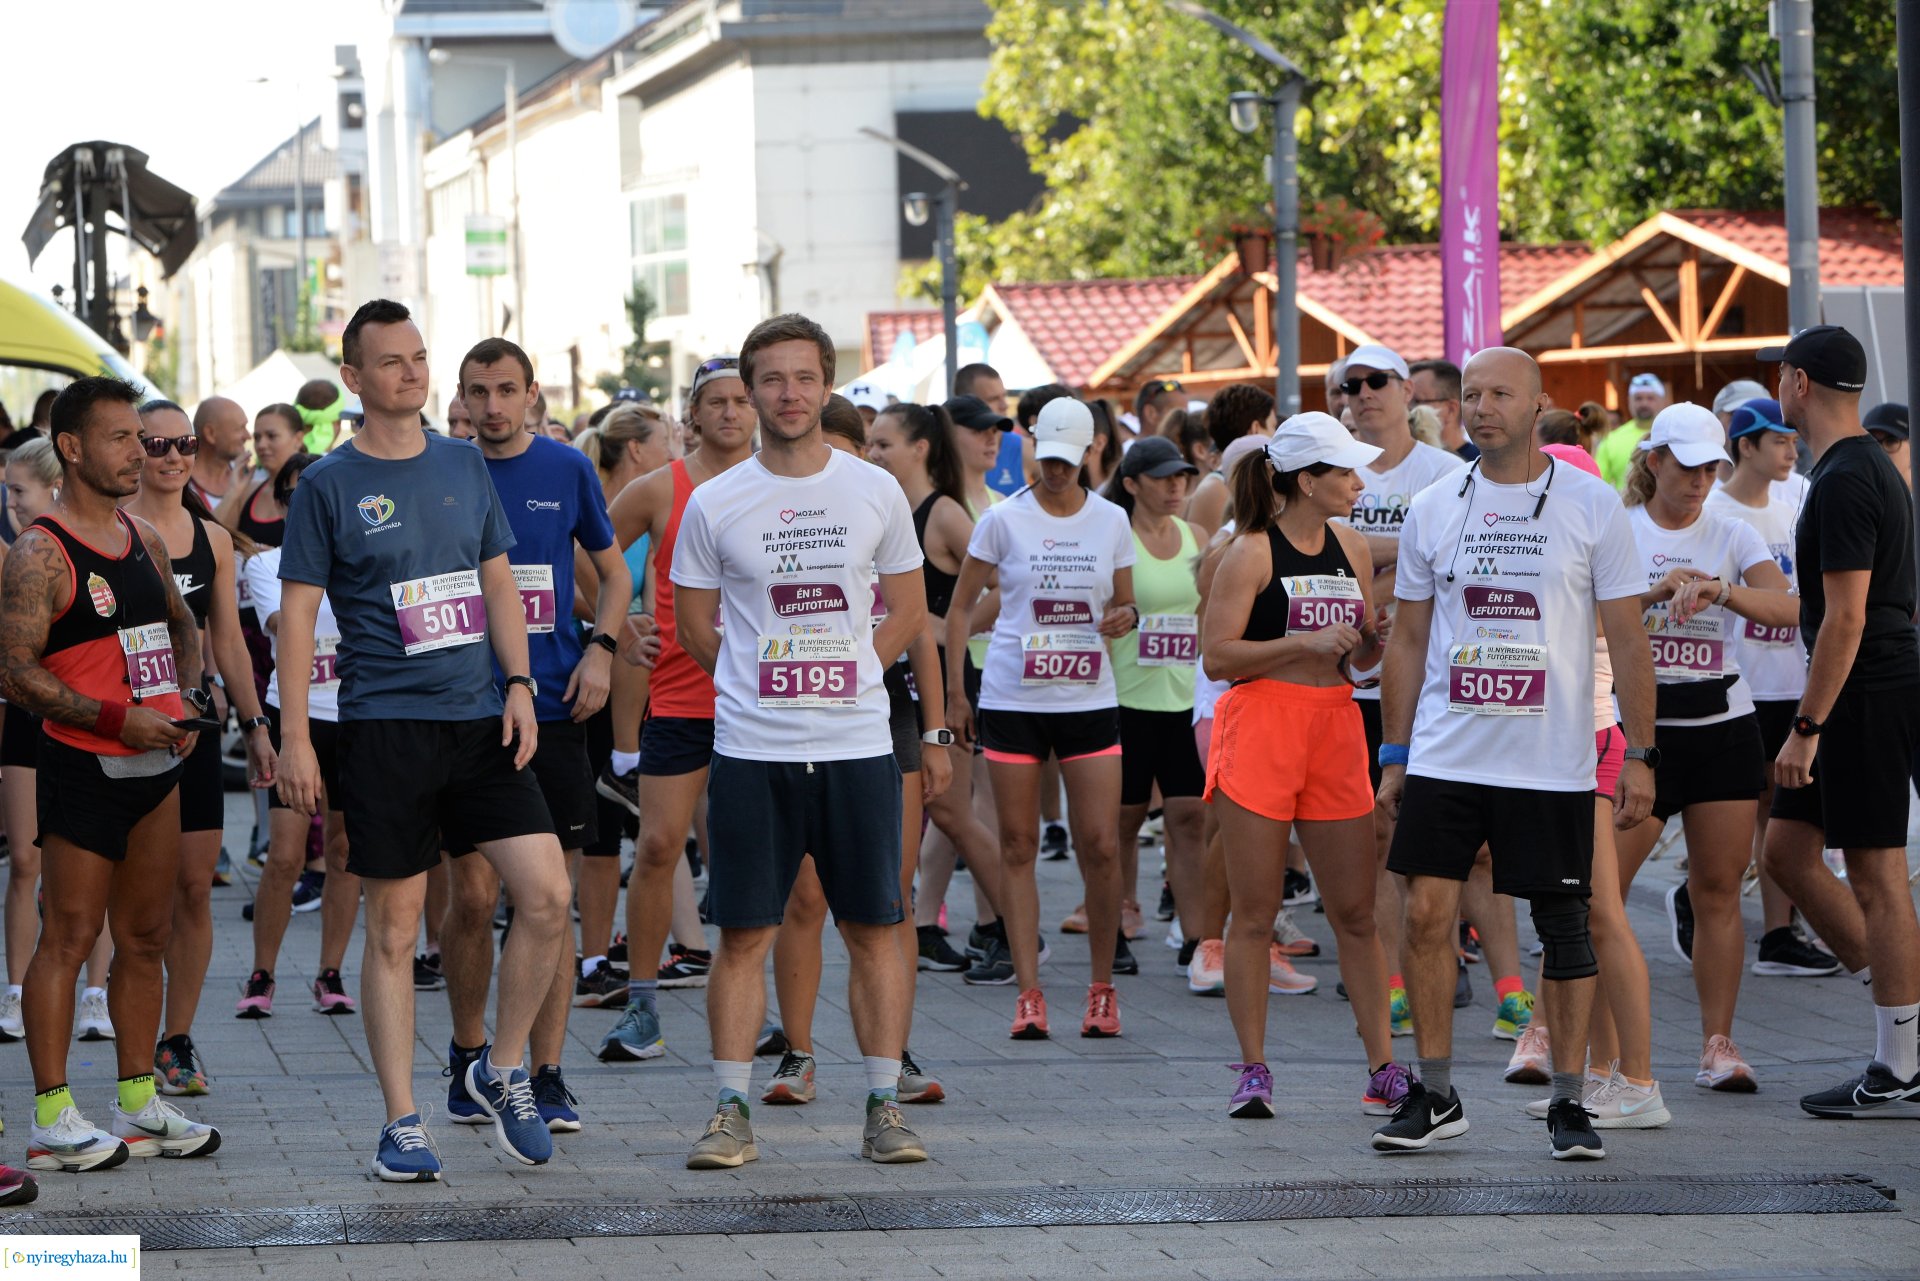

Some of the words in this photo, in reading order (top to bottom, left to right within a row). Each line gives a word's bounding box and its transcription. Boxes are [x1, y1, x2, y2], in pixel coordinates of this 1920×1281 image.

[795, 509, 827, 518] MOZAIK
[1350, 504, 1409, 525] FUTÁ
[1499, 515, 1529, 523] MOZAIK
[365, 521, 402, 536] NYÍREGYHÁZA
[762, 532, 775, 541] III.
[778, 525, 847, 540] NYÍREGYHÁZI
[1464, 534, 1476, 542] III.
[1479, 531, 1548, 543] NYÍREGYHÁZI
[765, 537, 846, 553] FUTÓFESZTIVÁL
[1465, 544, 1544, 556] FUTÓFESZTIVÁL
[1029, 554, 1039, 562] III.
[1042, 554, 1097, 563] NYÍREGYHÁZI
[1666, 556, 1693, 564] MOZAIK
[1031, 562, 1096, 573] FUTÓFESZTIVÁL
[434, 583, 476, 593] FUTÓFESZTIVÁL
[796, 587, 810, 599] ÉN
[812, 587, 823, 598] IS
[1488, 592, 1502, 603] ÉN
[1504, 594, 1514, 603] IS
[780, 599, 843, 614] LEFUTOTTAM
[1053, 601, 1065, 613] ÉN
[1066, 603, 1075, 612] IS
[1471, 606, 1536, 617] LEFUTOTTAM
[422, 601, 470, 634] 501
[1038, 612, 1090, 624] LEFUTOTTAM
[1300, 602, 1357, 627] 5005
[799, 645, 851, 653] FUTÓFESZTIVÁL
[1147, 635, 1192, 657] 5112
[1487, 653, 1540, 662] FUTÓFESZTIVÁL
[1649, 639, 1712, 666] 5080
[1033, 654, 1092, 676] 5076
[771, 666, 845, 692] 5195
[1460, 672, 1533, 701] 5057
